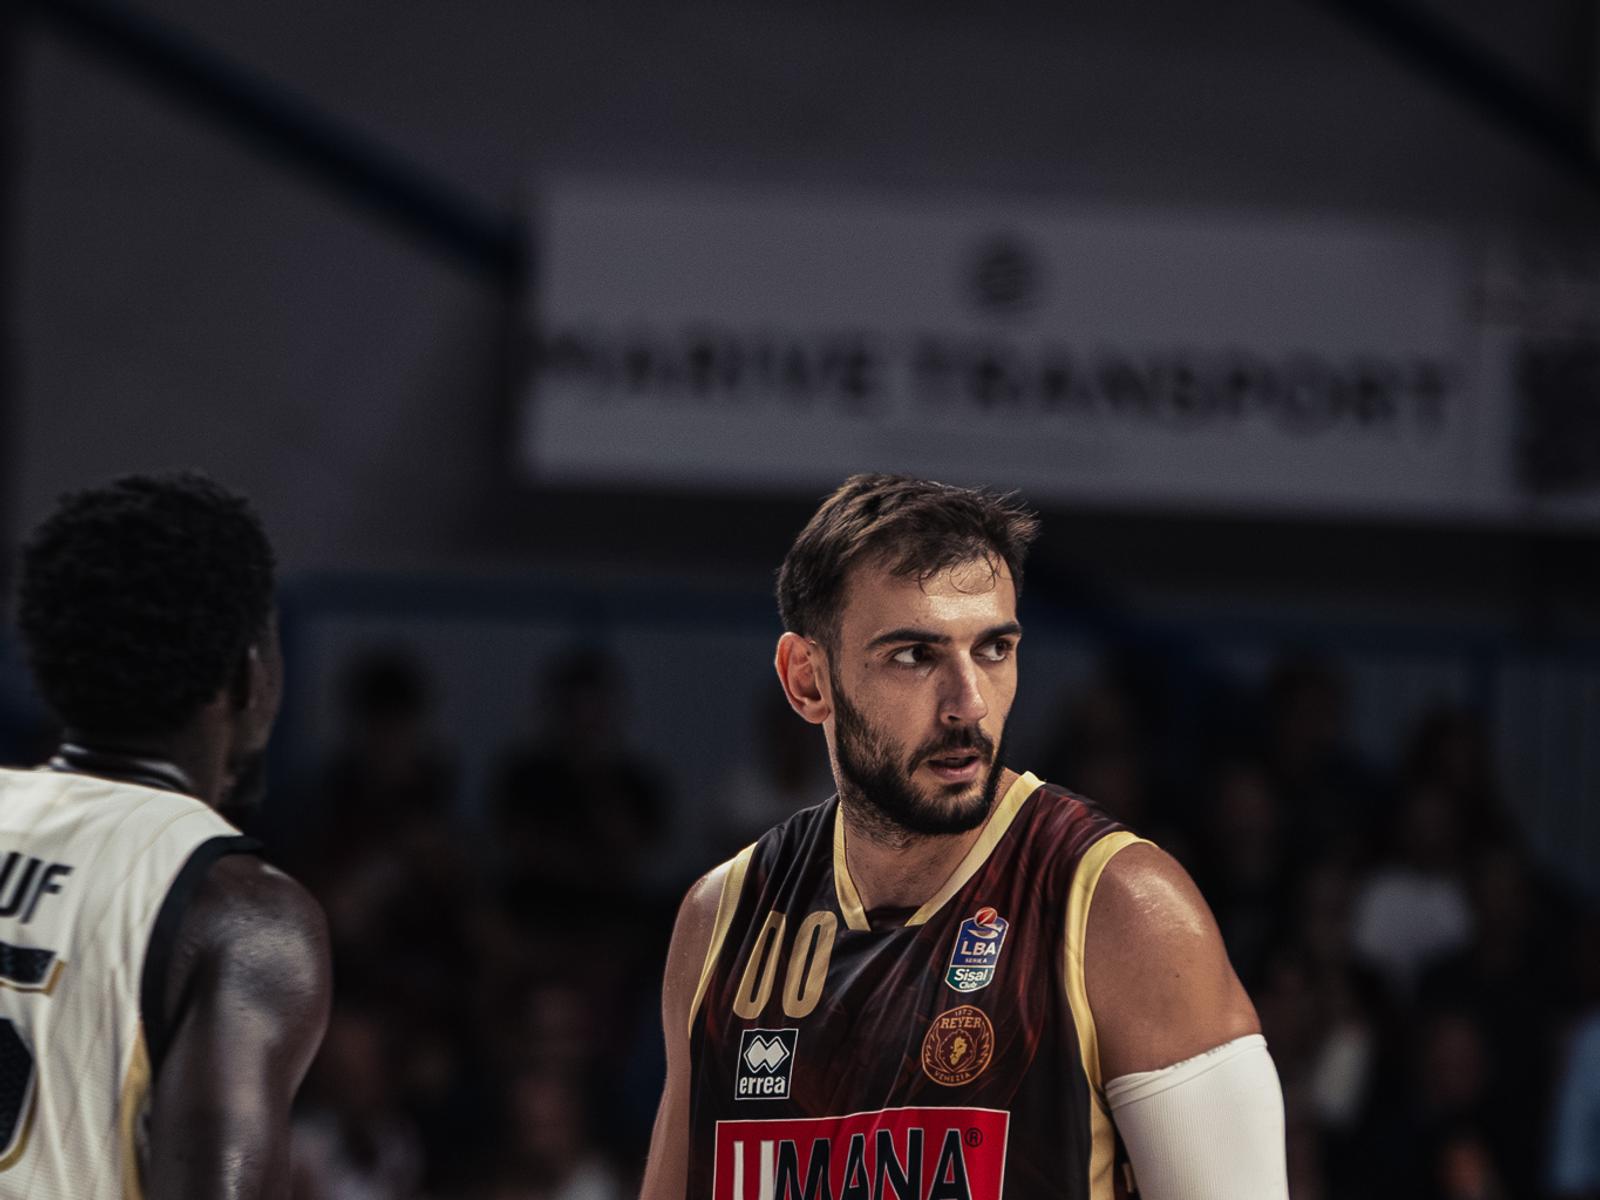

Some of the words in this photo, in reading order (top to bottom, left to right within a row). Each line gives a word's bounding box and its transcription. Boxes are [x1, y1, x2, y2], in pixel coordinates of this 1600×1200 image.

[960, 940, 996, 956] LBA
[733, 910, 838, 1019] 00
[953, 968, 988, 982] Sisal
[939, 1016, 982, 1029] REYER
[934, 1070, 972, 1082] VENEZIA
